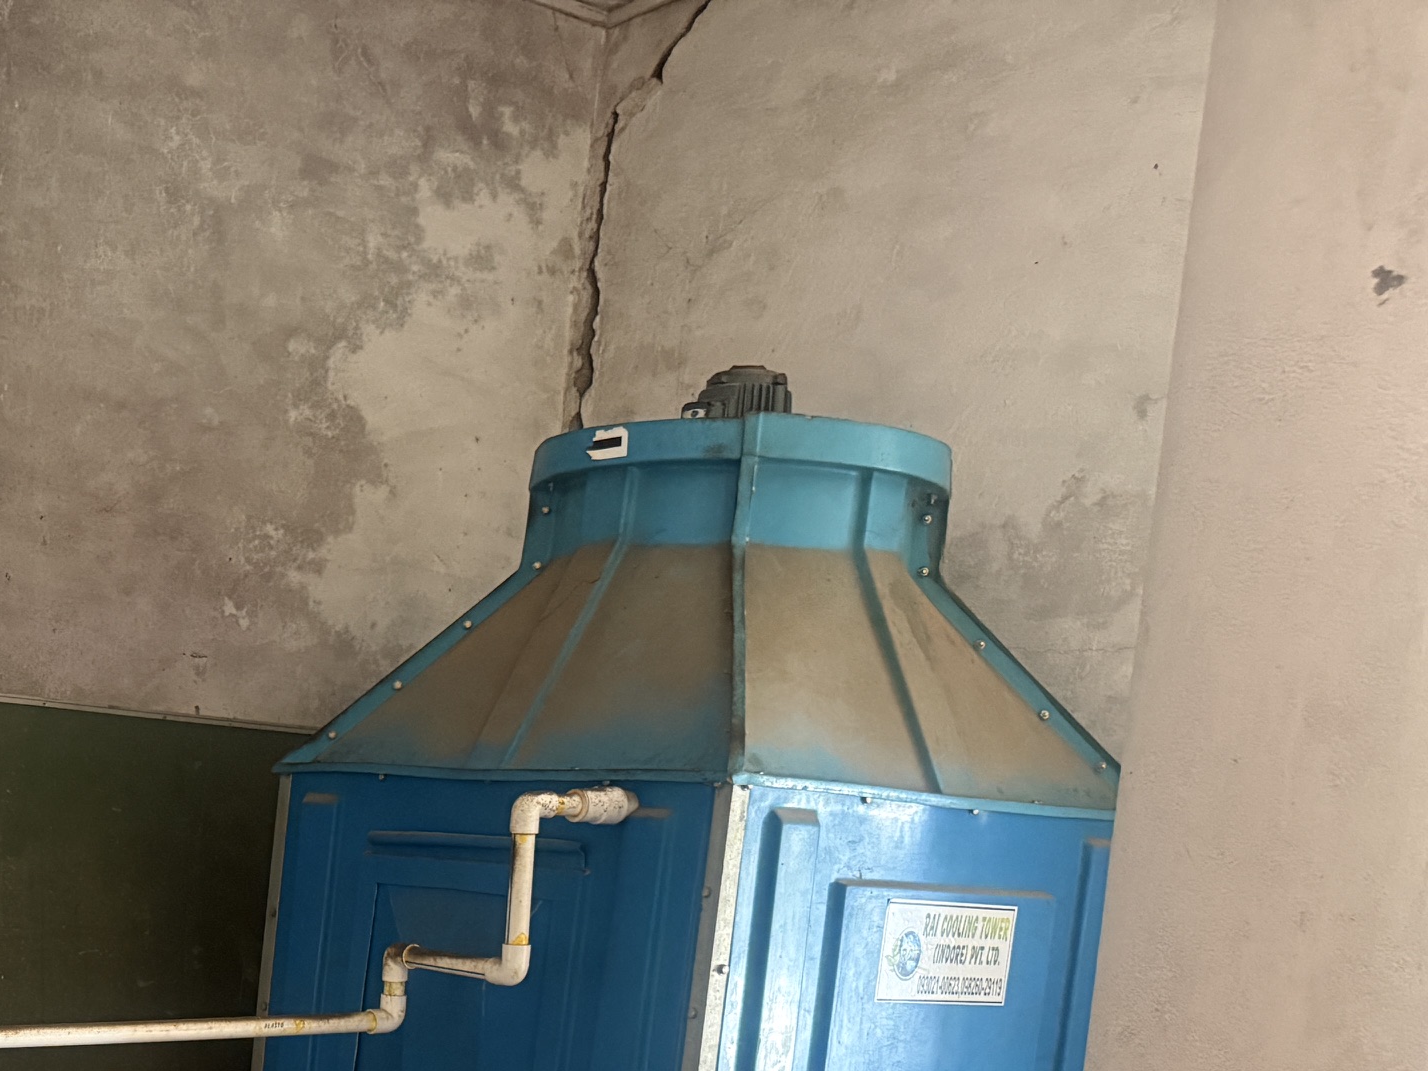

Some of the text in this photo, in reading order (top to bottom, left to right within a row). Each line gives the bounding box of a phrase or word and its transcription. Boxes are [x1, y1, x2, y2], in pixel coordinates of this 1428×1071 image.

[924, 913, 1010, 942] RAI COOLING TOWER
[933, 944, 968, 966] (INDORE)
[986, 946, 1001, 966] LTD.
